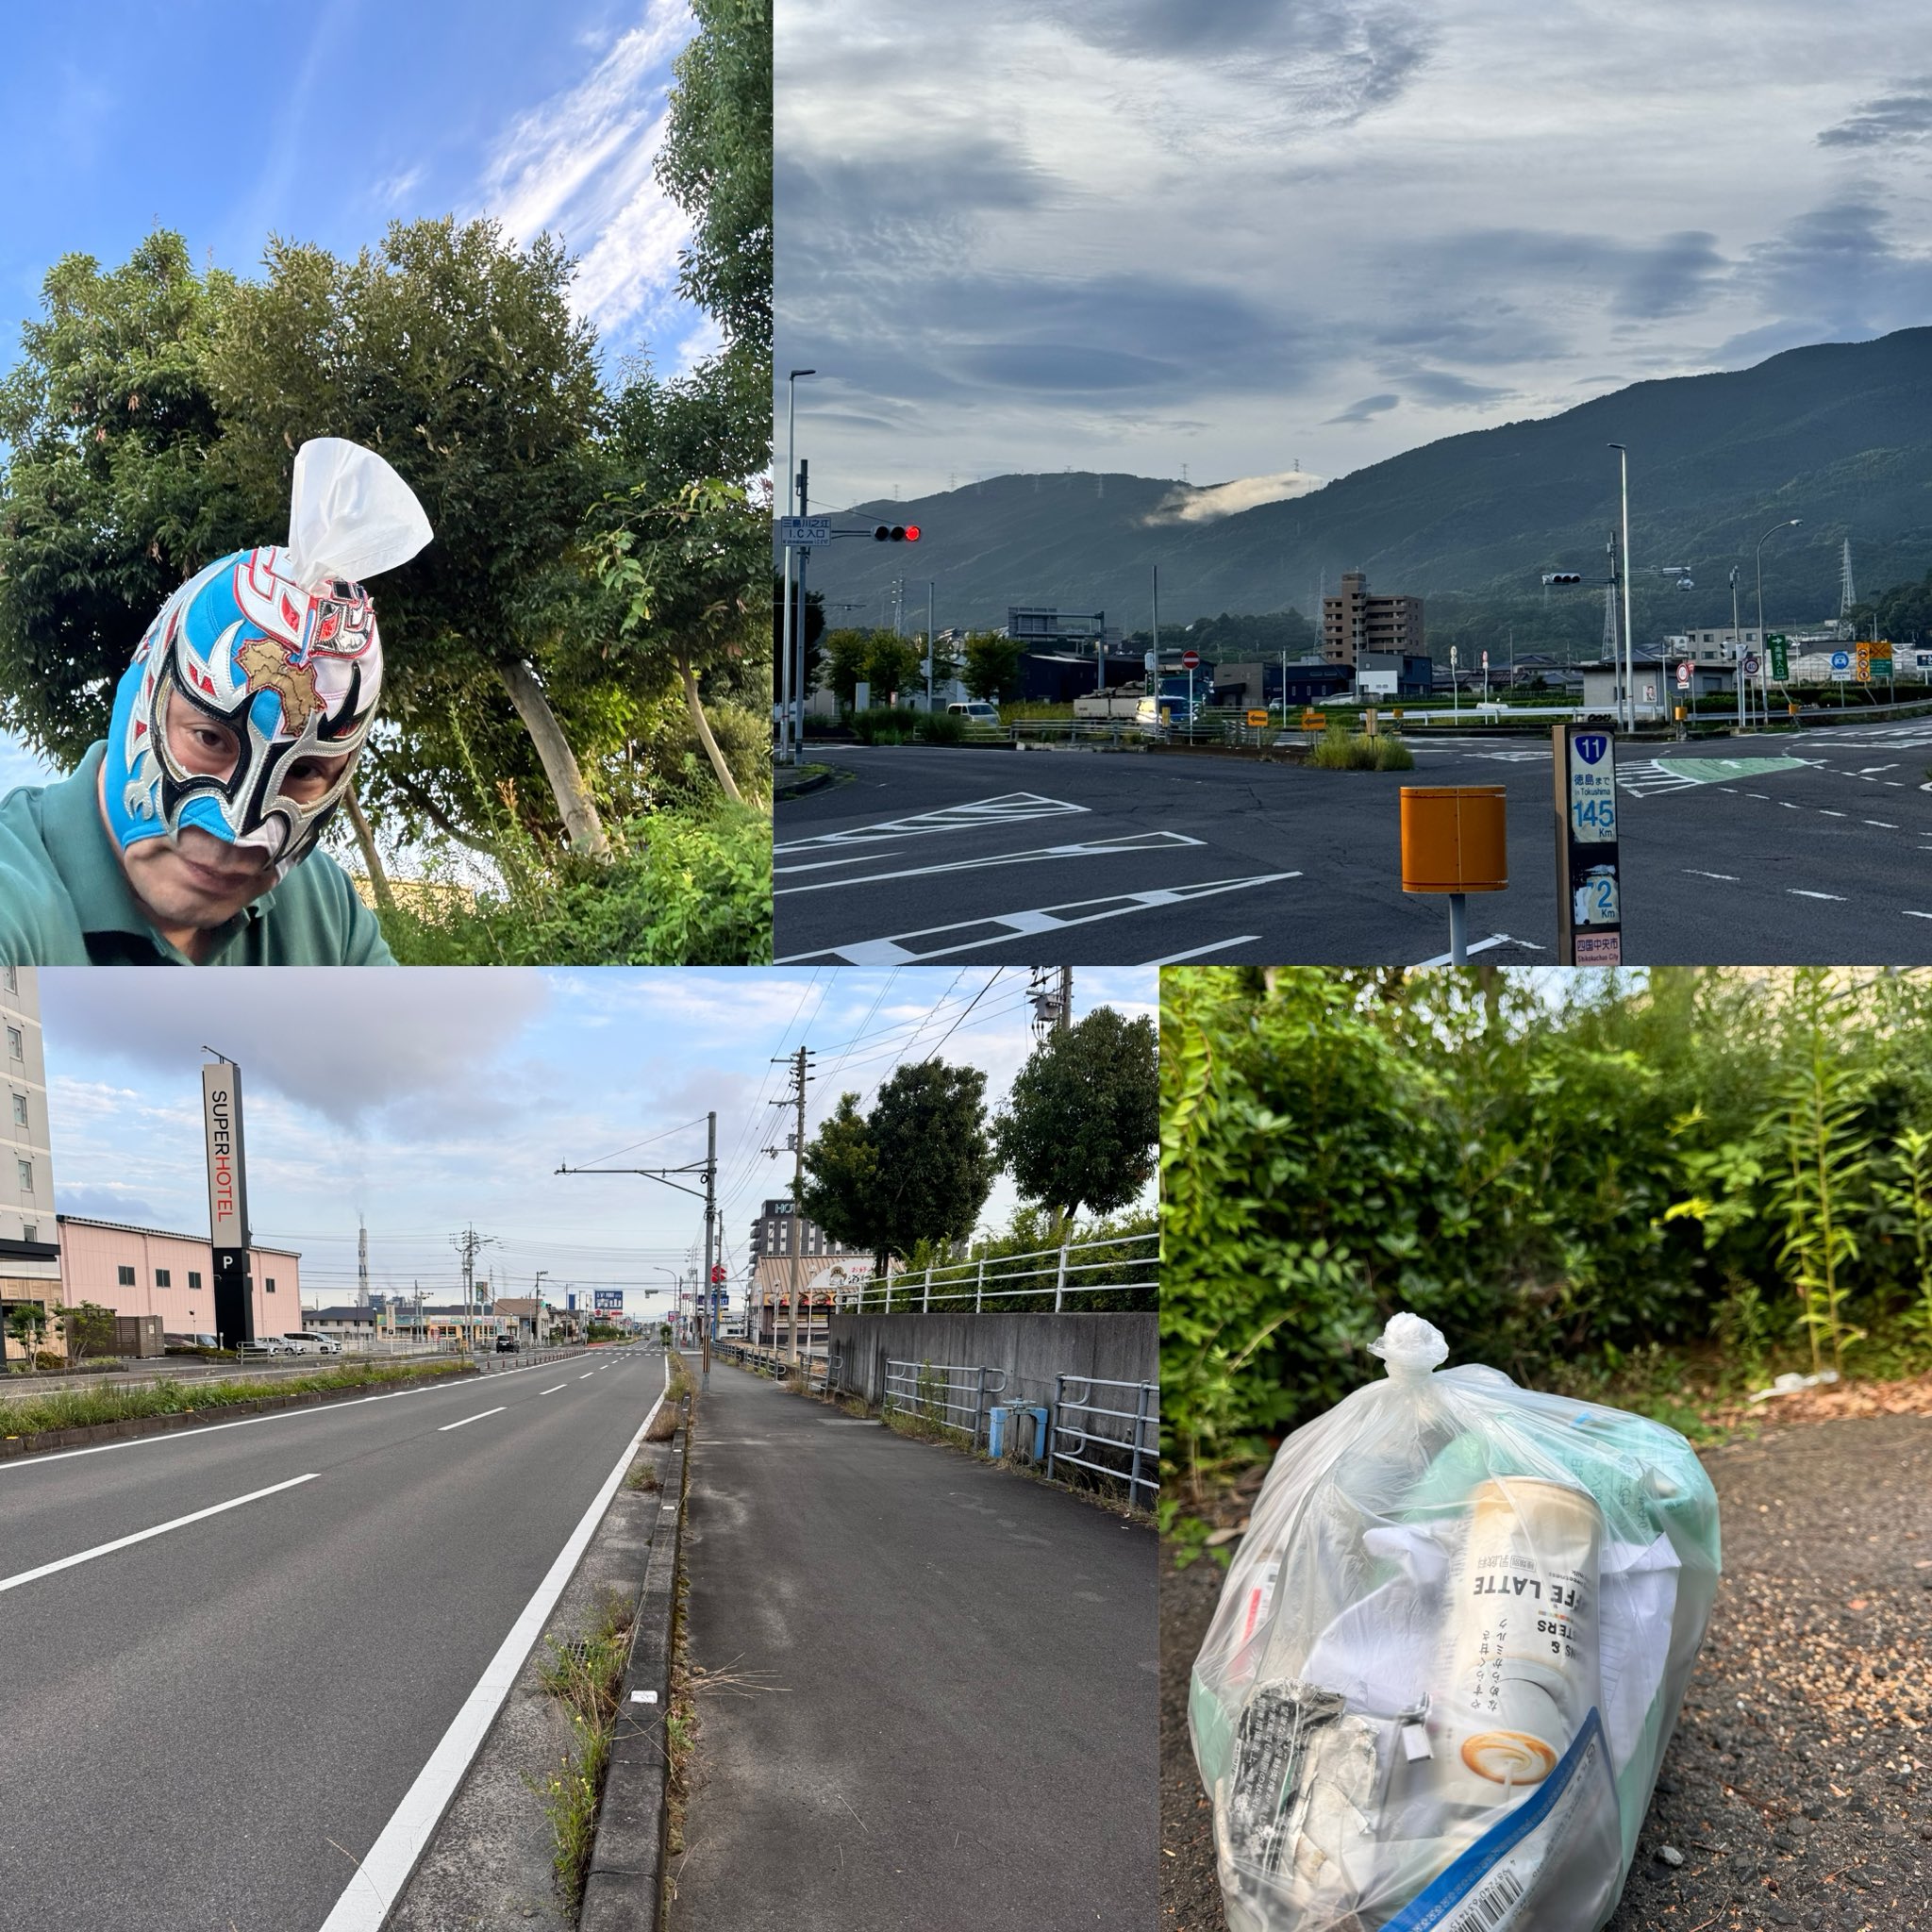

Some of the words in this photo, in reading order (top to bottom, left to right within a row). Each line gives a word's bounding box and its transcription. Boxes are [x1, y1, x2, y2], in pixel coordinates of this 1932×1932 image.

[783, 519, 829, 527] 三島川之江
[1582, 739, 1600, 758] 11
[1574, 774, 1609, 785] 徳島まで
[1581, 788, 1610, 796] Tokushima
[1574, 800, 1614, 827] 145
[1599, 829, 1612, 838] Km
[1601, 908, 1615, 918] Km
[1577, 938, 1618, 952] 四国中央市
[1608, 953, 1618, 961] City
[223, 1256, 233, 1269] P
[1478, 1555, 1508, 1569] 乳飲料
[1474, 1575, 1541, 1599] LATTE
[1551, 1641, 1560, 1654] &
[1488, 1618, 1507, 1711] なめらかミルク
